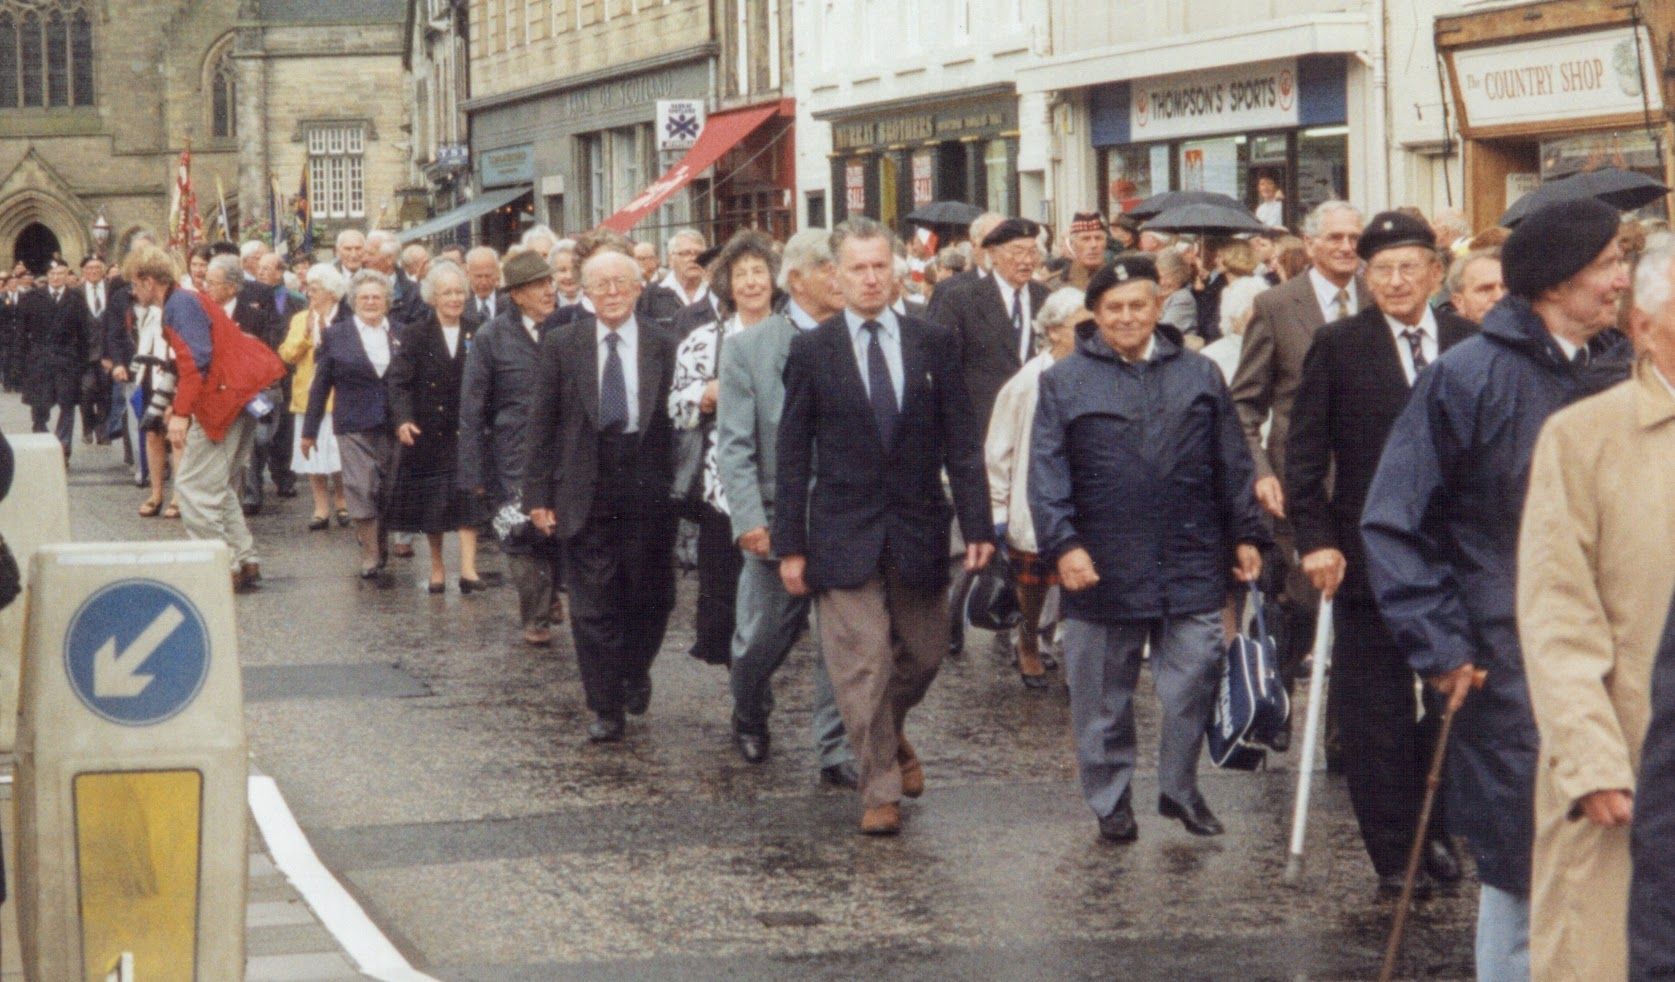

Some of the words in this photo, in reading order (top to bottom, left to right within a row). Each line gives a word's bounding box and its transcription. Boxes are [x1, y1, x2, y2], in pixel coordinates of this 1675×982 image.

[1150, 83, 1224, 121] THOMPSON'S
[1230, 76, 1276, 112] SPORTS
[1466, 74, 1480, 90] The
[1484, 65, 1554, 101] COUNTRY
[1560, 58, 1604, 92] SHOP
